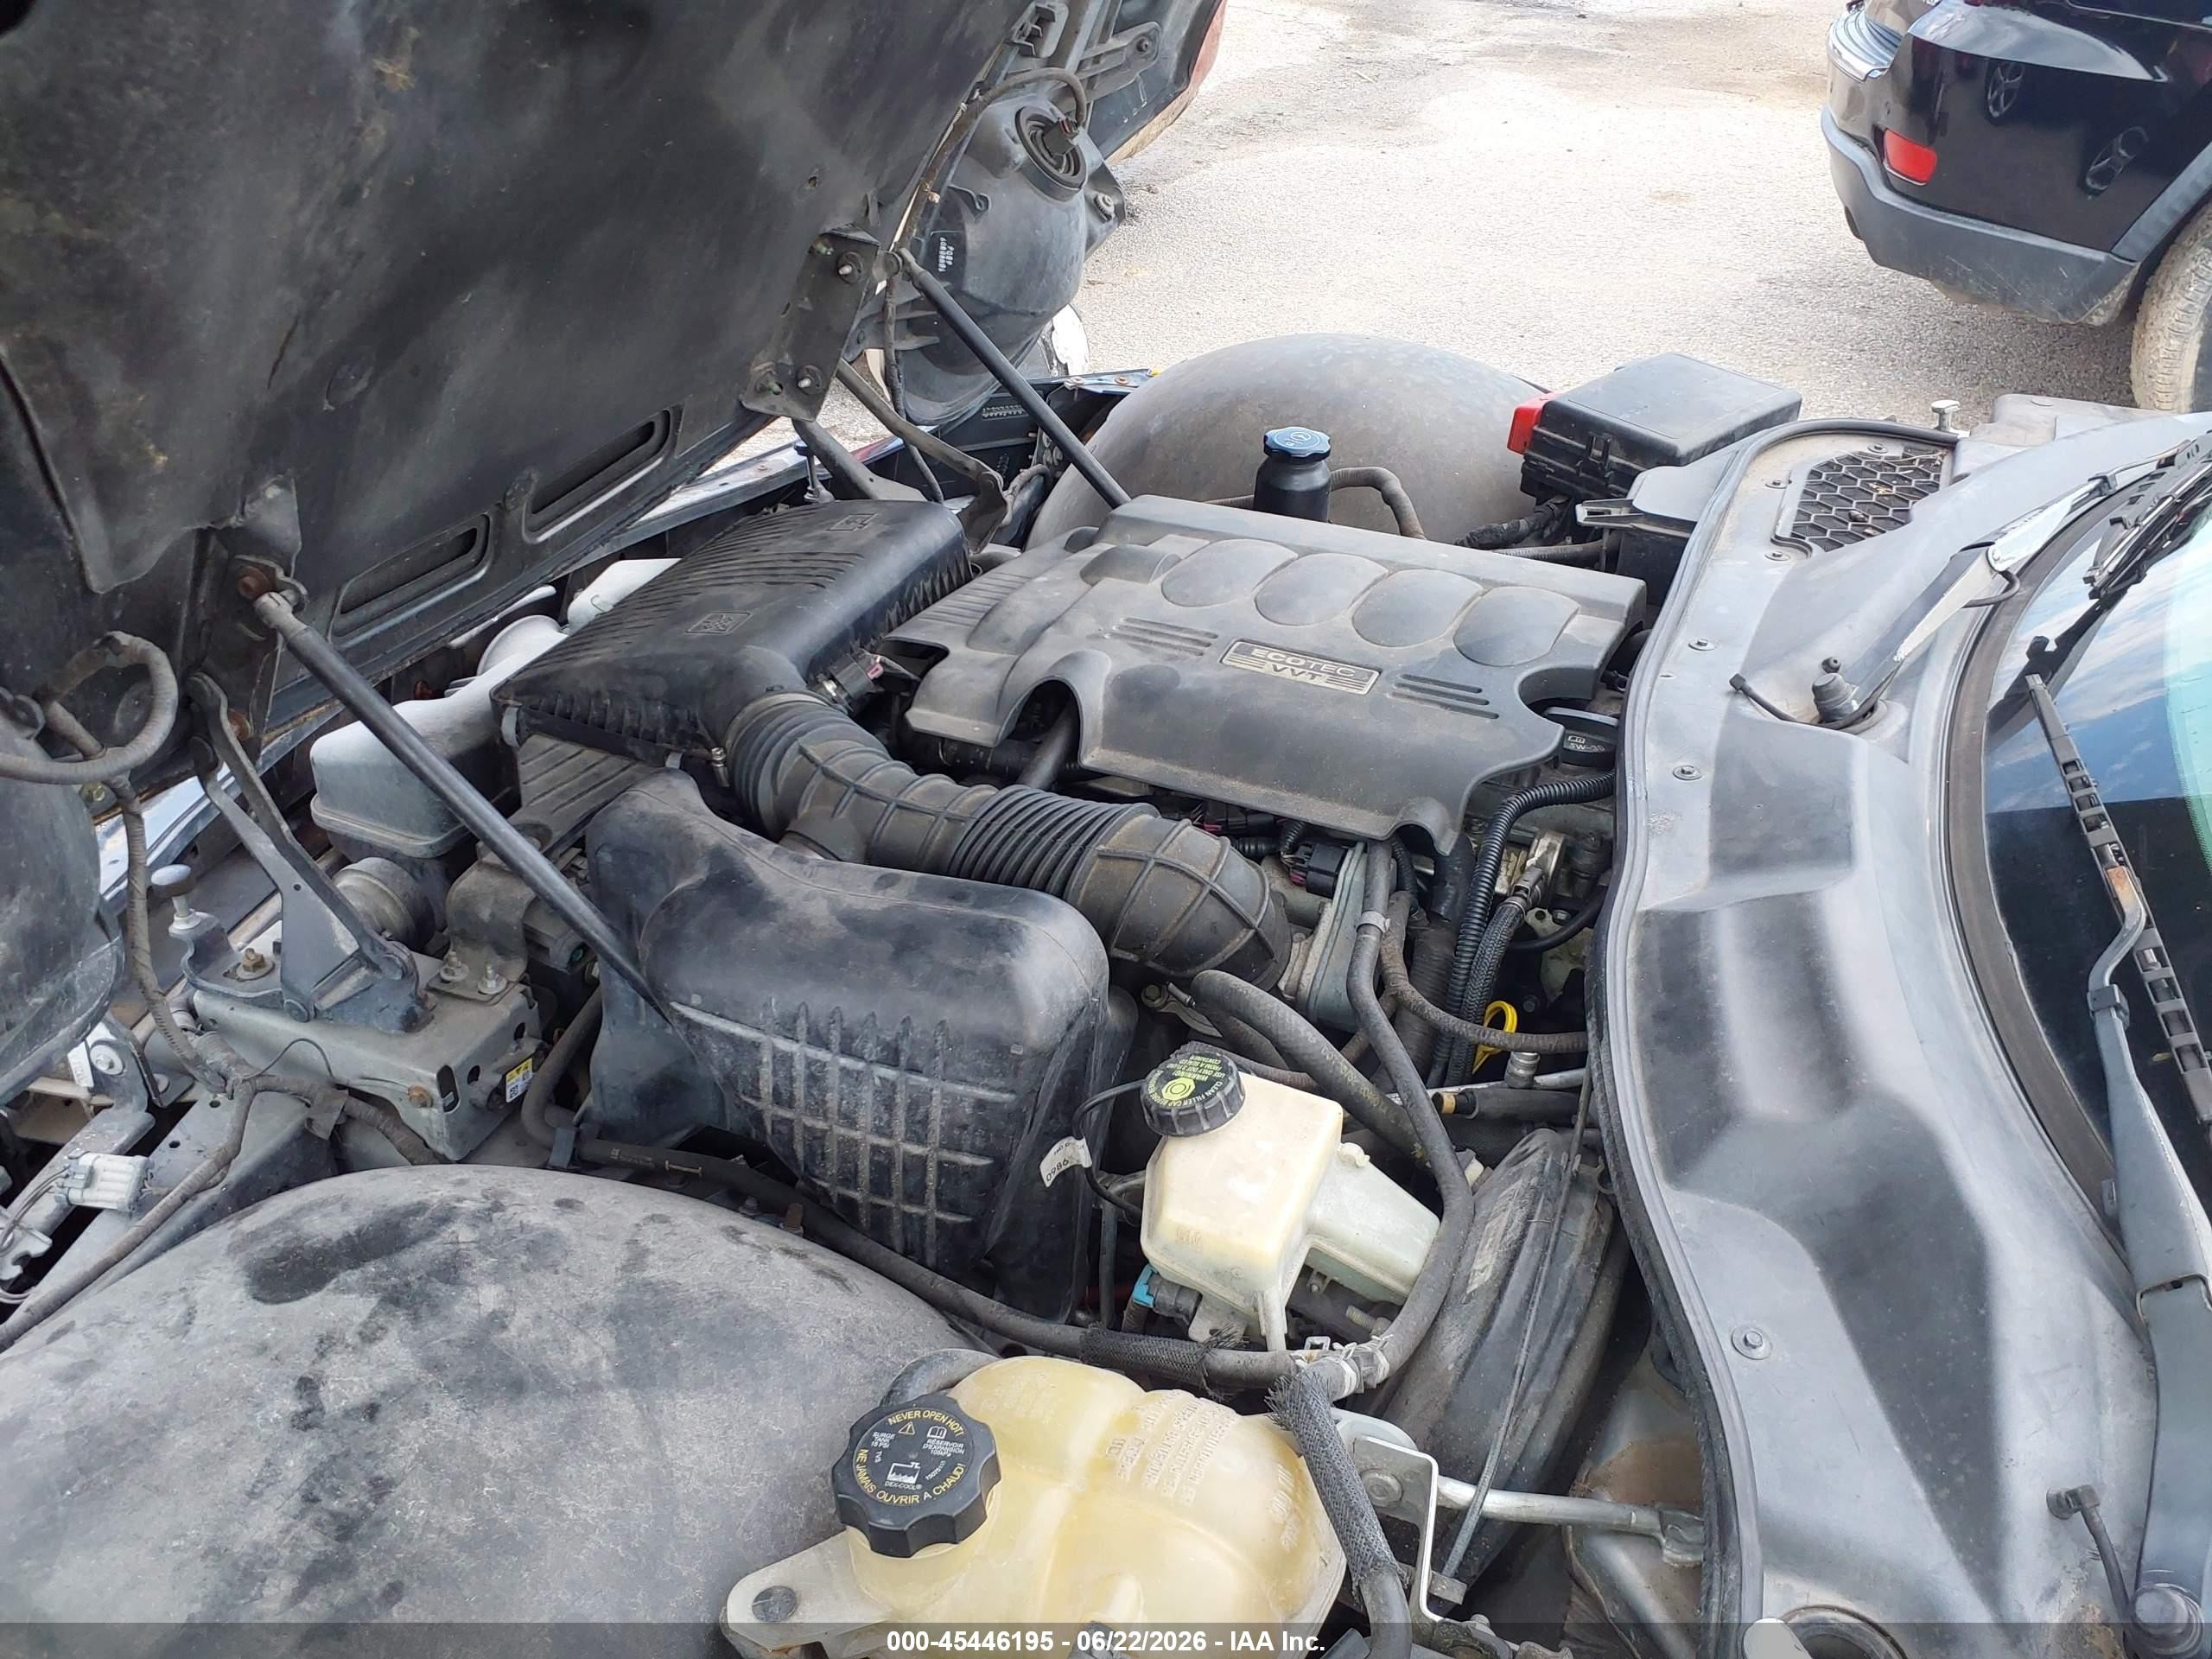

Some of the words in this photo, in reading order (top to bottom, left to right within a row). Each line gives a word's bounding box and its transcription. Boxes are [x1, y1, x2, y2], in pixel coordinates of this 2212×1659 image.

[1250, 648, 1356, 677] ECOTEC
[1272, 664, 1323, 681] VVT
[1212, 1071, 1226, 1079] USE
[1205, 1081, 1223, 1096] CLEAN
[1182, 1093, 1205, 1107] FILLER
[888, 1410, 921, 1426] NEVER
[923, 1410, 948, 1423] OPEN
[946, 1417, 964, 1436] HOT!
[872, 1431, 896, 1440] SURGE
[856, 1448, 869, 1463] NE
[856, 1464, 877, 1493] JAMAIS
[932, 1463, 966, 1495] CHAUD!
[876, 1491, 920, 1504] OUVRIR
